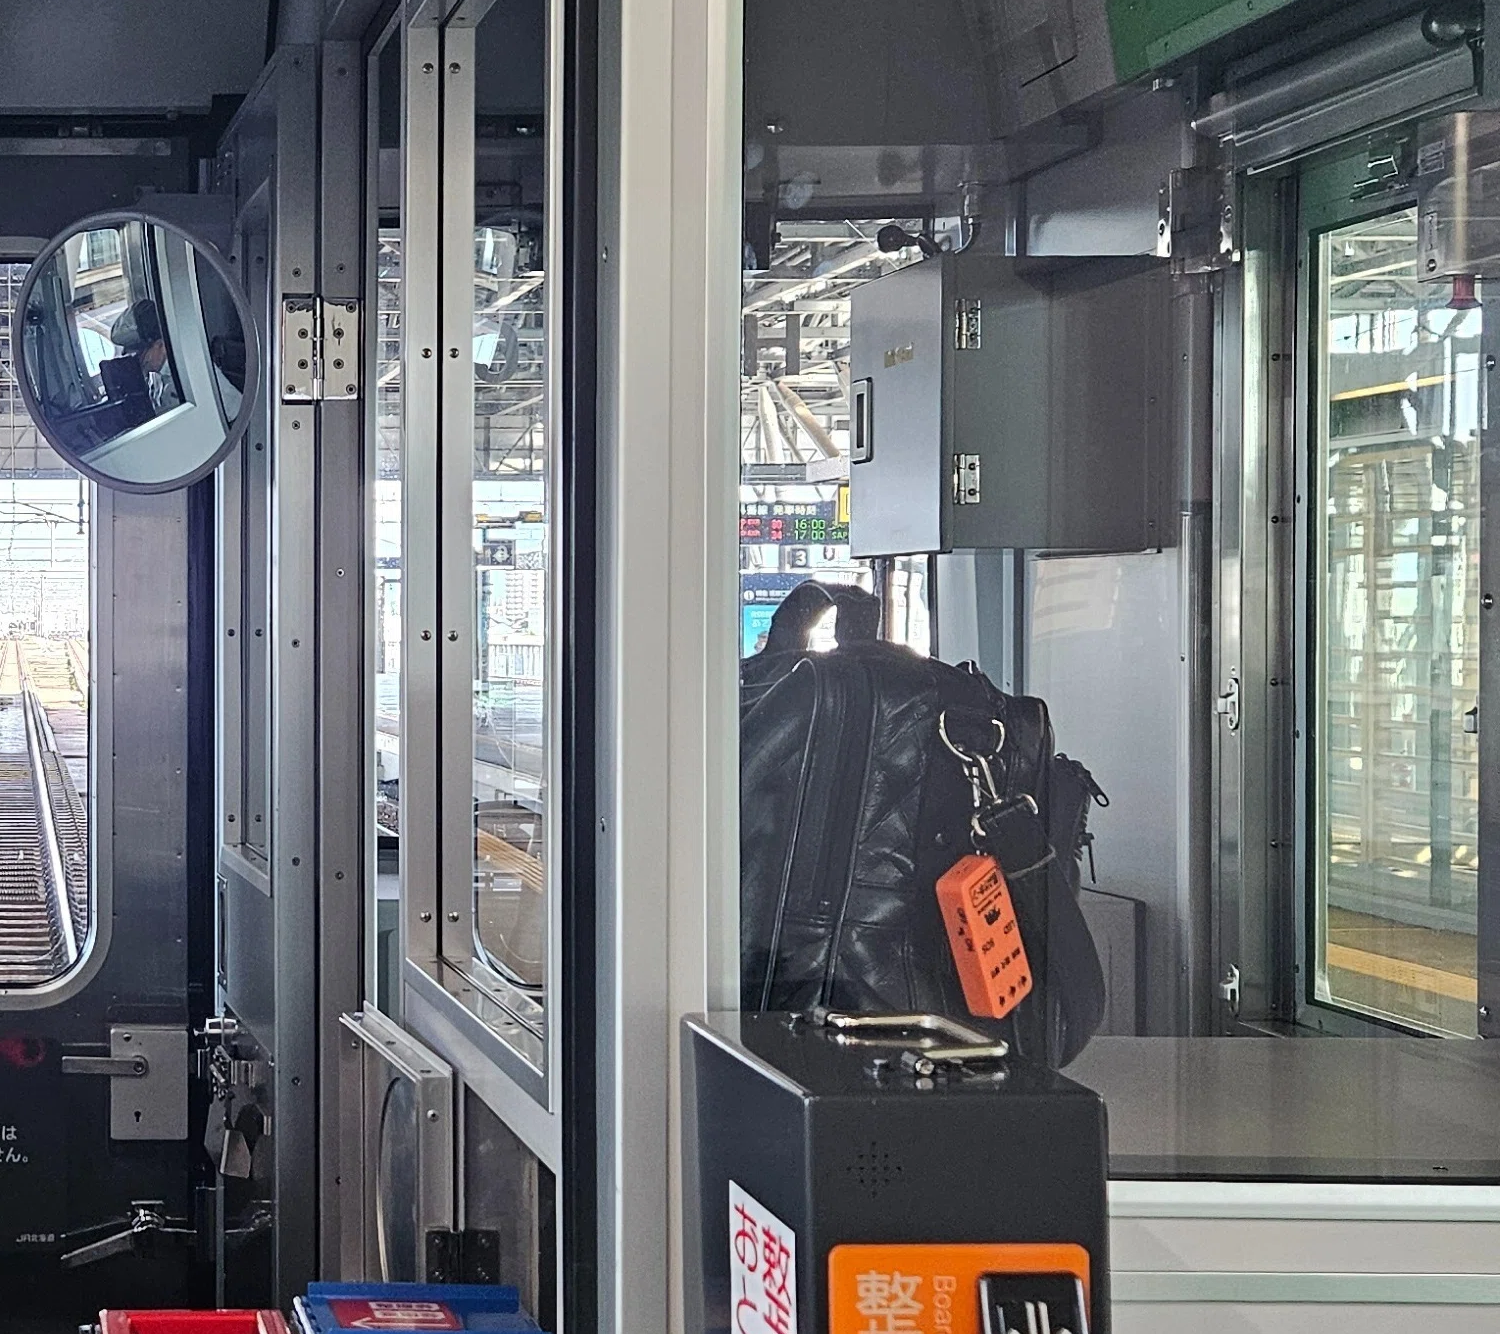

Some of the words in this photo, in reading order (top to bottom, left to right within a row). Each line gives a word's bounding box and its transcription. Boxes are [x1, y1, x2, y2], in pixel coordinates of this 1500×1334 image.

[794, 519, 826, 530] 16:00
[794, 529, 826, 541] 17:00
[795, 550, 807, 567] 3
